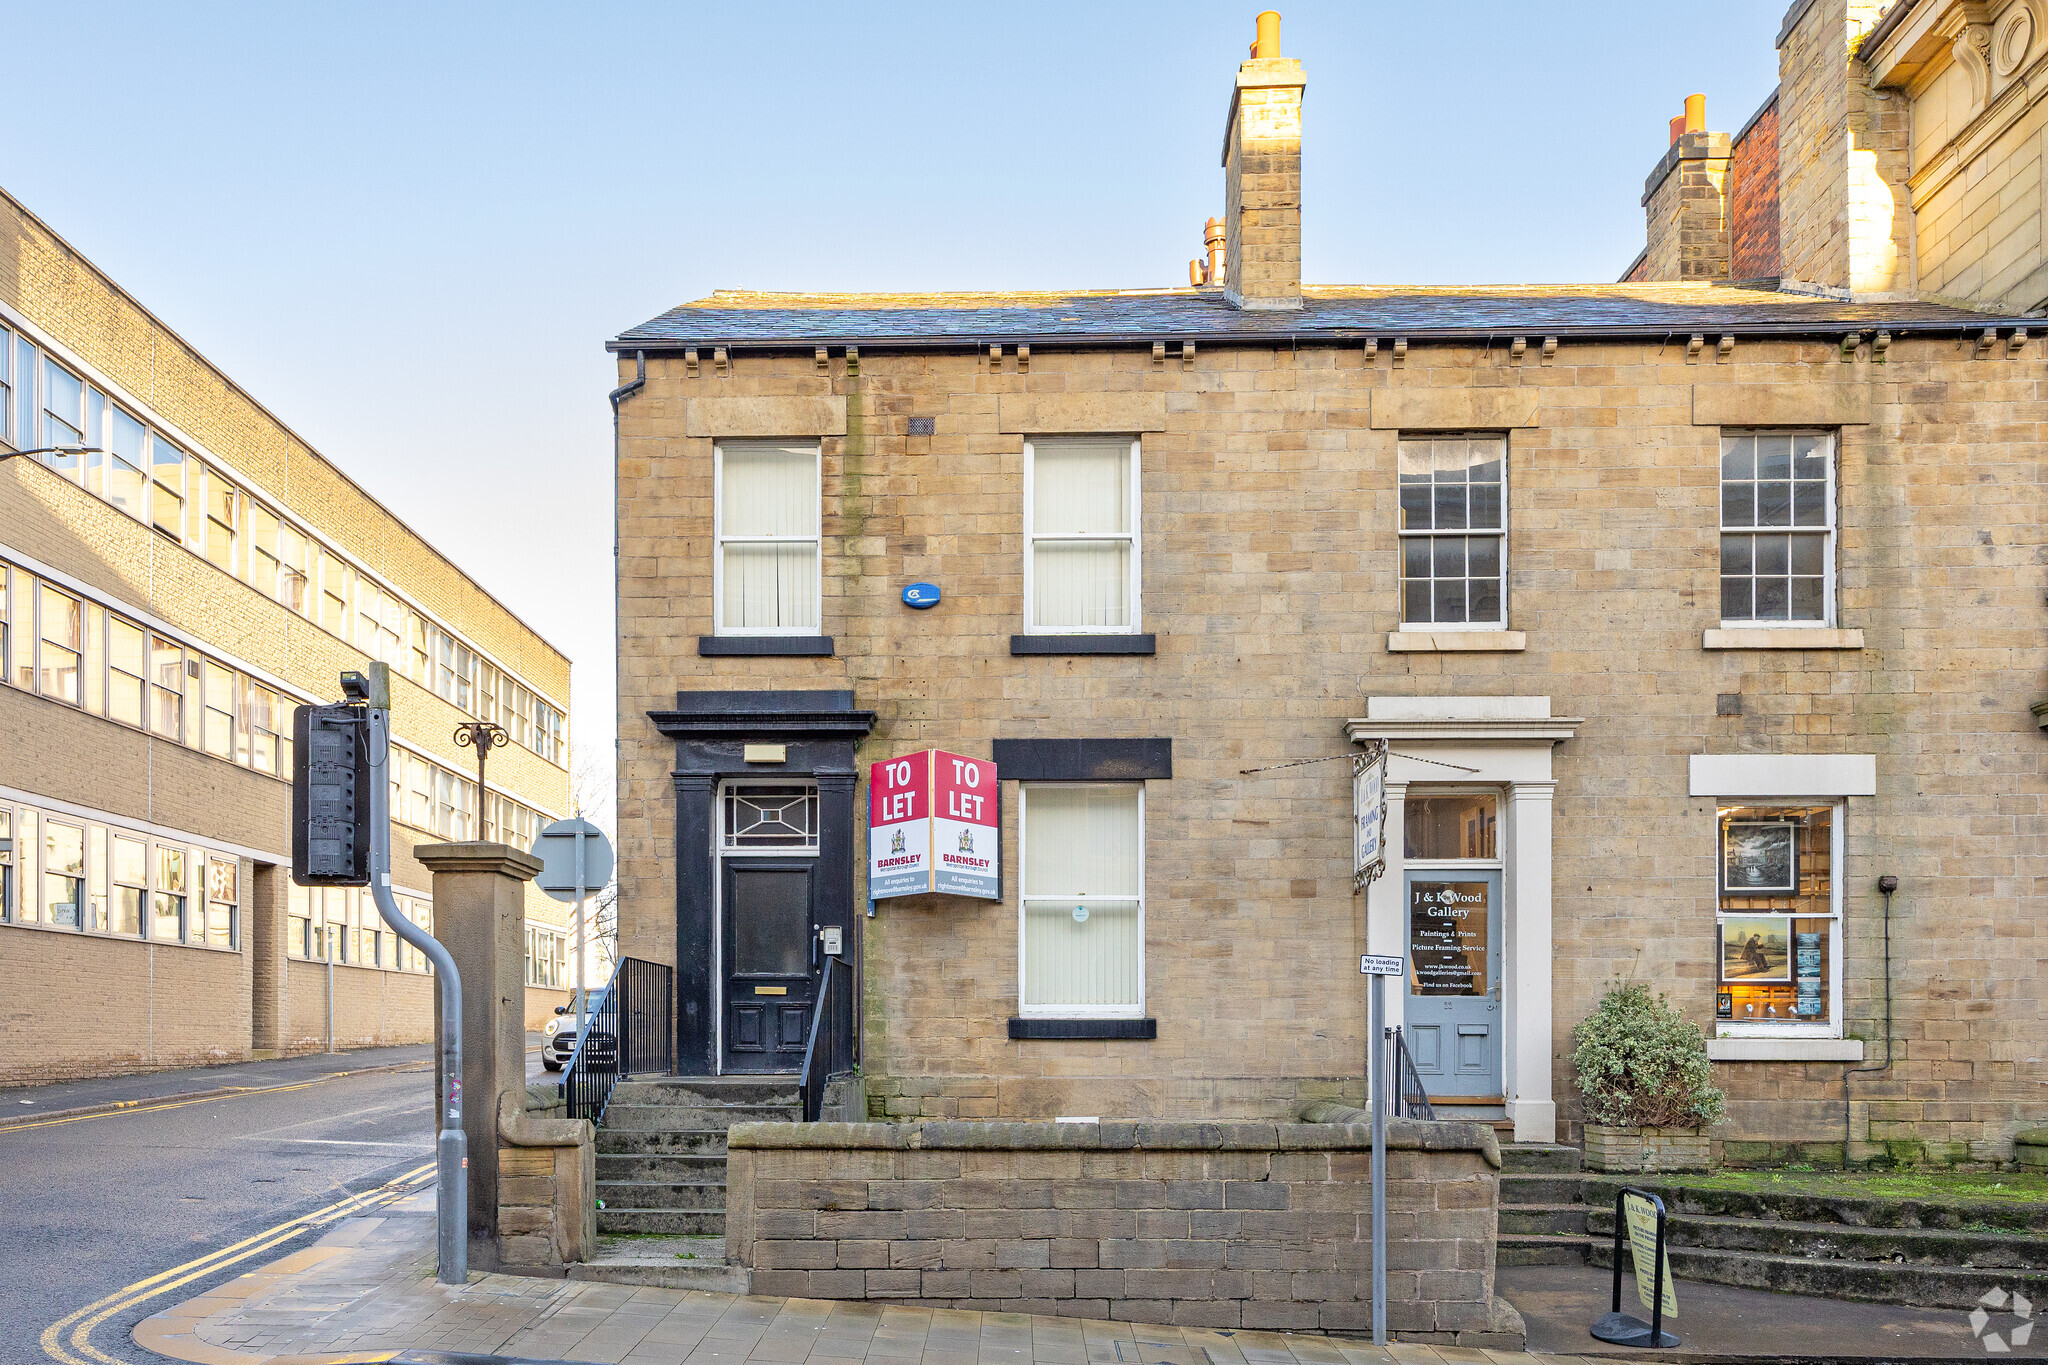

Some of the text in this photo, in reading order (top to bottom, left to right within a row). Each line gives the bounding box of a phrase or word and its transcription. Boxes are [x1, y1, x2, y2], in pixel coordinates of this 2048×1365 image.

[885, 760, 911, 789] TO
[952, 759, 980, 788] TO
[882, 790, 916, 822] LET
[949, 790, 984, 821] LET
[1361, 806, 1378, 830] FRAMING
[1362, 837, 1377, 858] GALLERY
[878, 854, 921, 868] BARNSLEY
[943, 854, 990, 867] BARNSLEY
[958, 877, 978, 885] enquiries
[1414, 891, 1482, 905] J & K Wood
[1427, 906, 1470, 920] Gallery
[1420, 930, 1450, 939] Paintings
[1435, 944, 1462, 953] Framing
[1462, 944, 1485, 952] Service
[1375, 958, 1400, 967] loading
